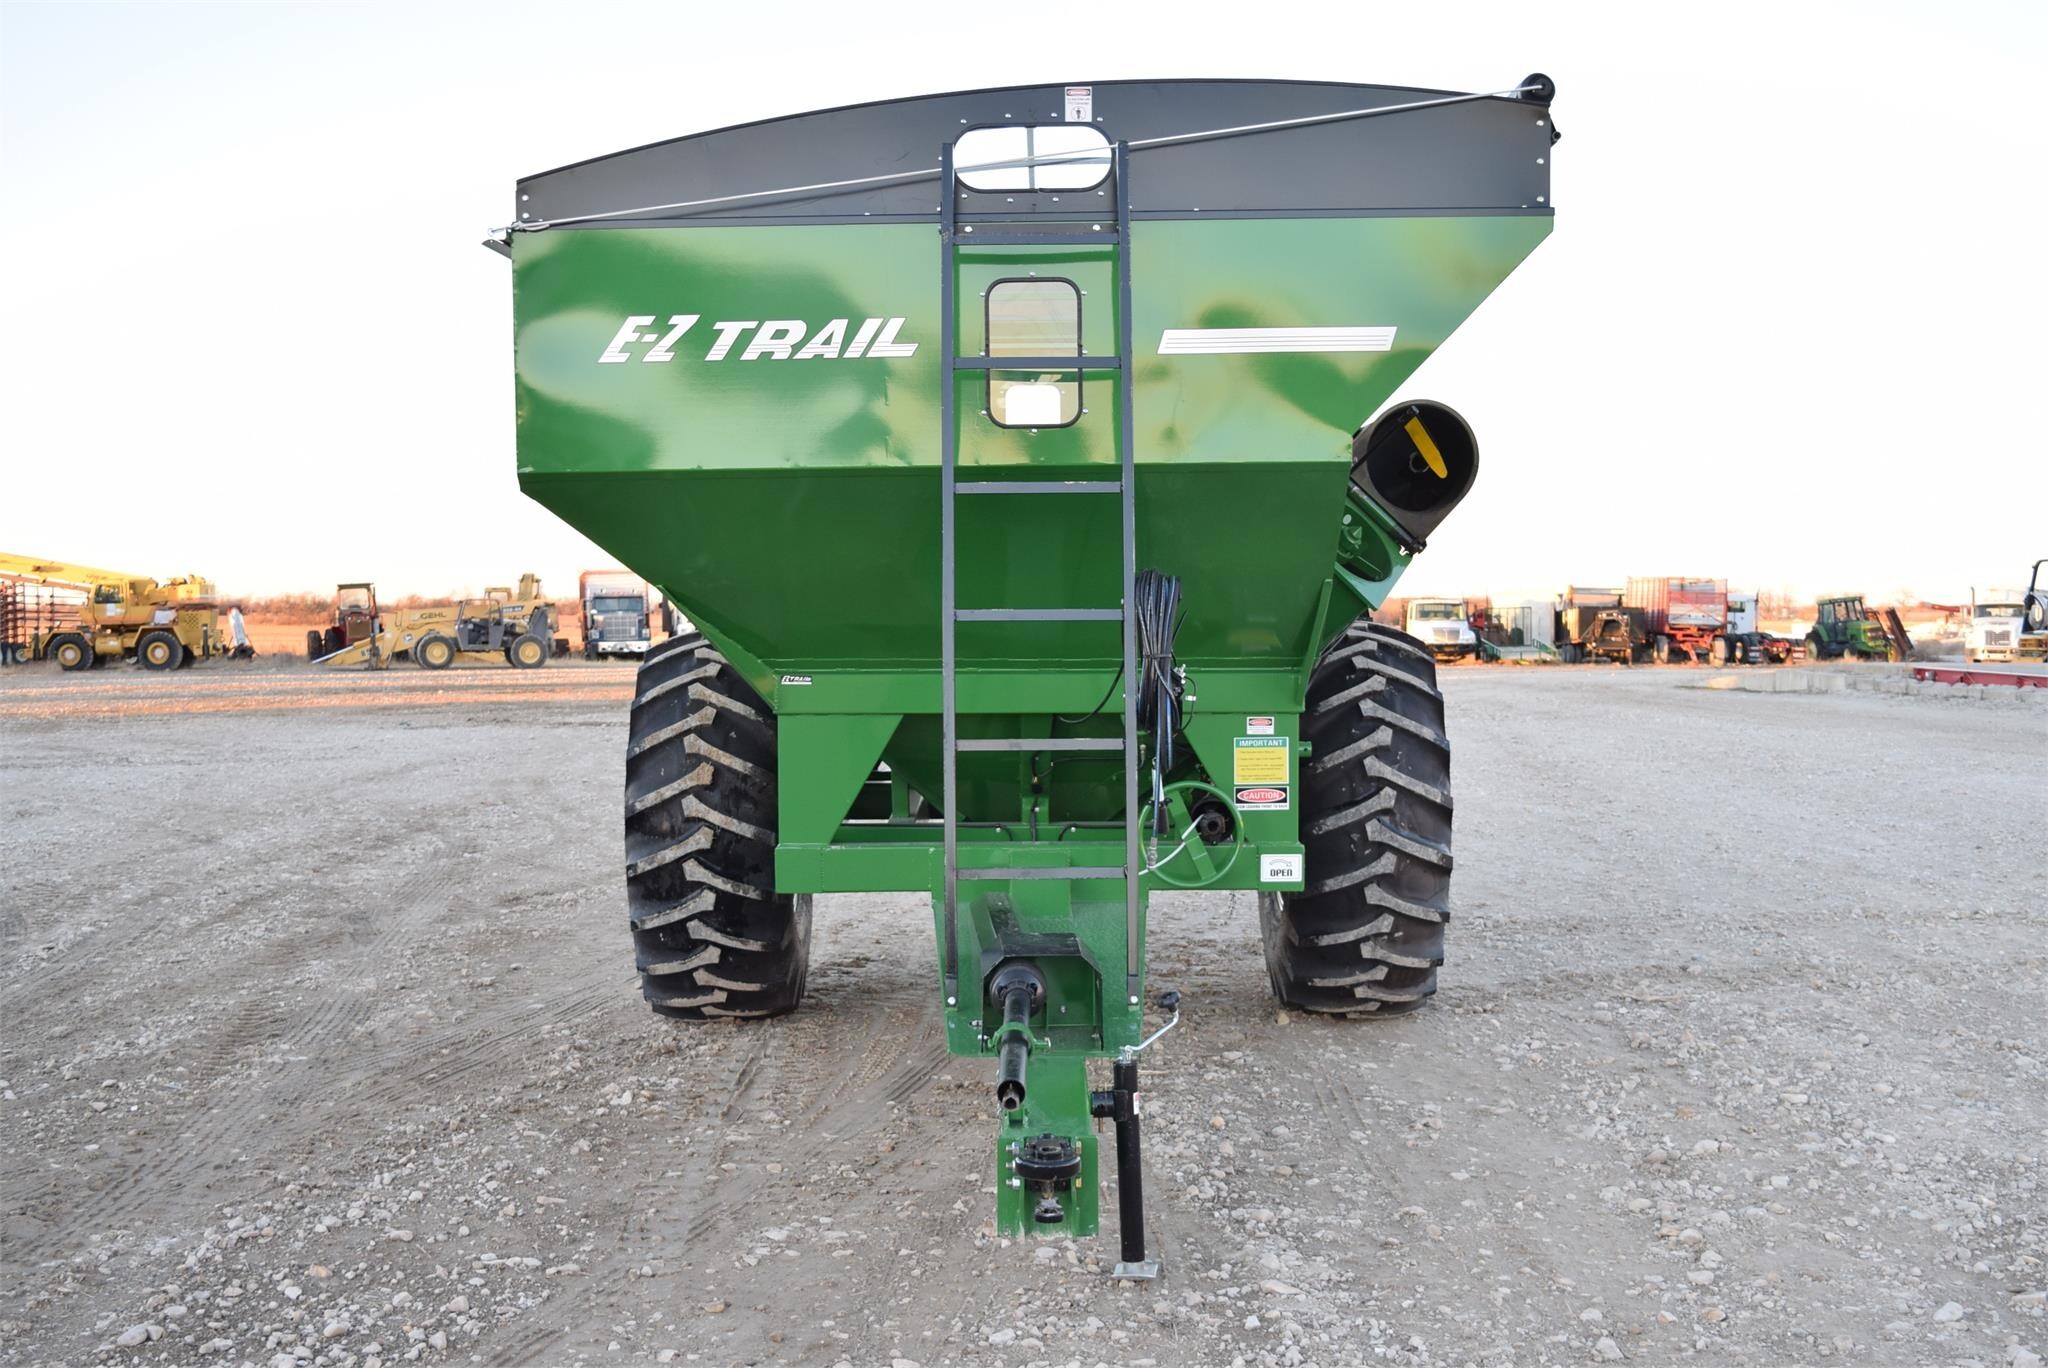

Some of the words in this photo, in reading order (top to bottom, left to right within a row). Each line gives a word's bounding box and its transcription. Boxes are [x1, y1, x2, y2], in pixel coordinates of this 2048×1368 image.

[597, 314, 701, 364] E-Z
[704, 317, 919, 362] TRAIL
[1243, 791, 1280, 799] CAUTION
[1270, 868, 1293, 877] OPEN
